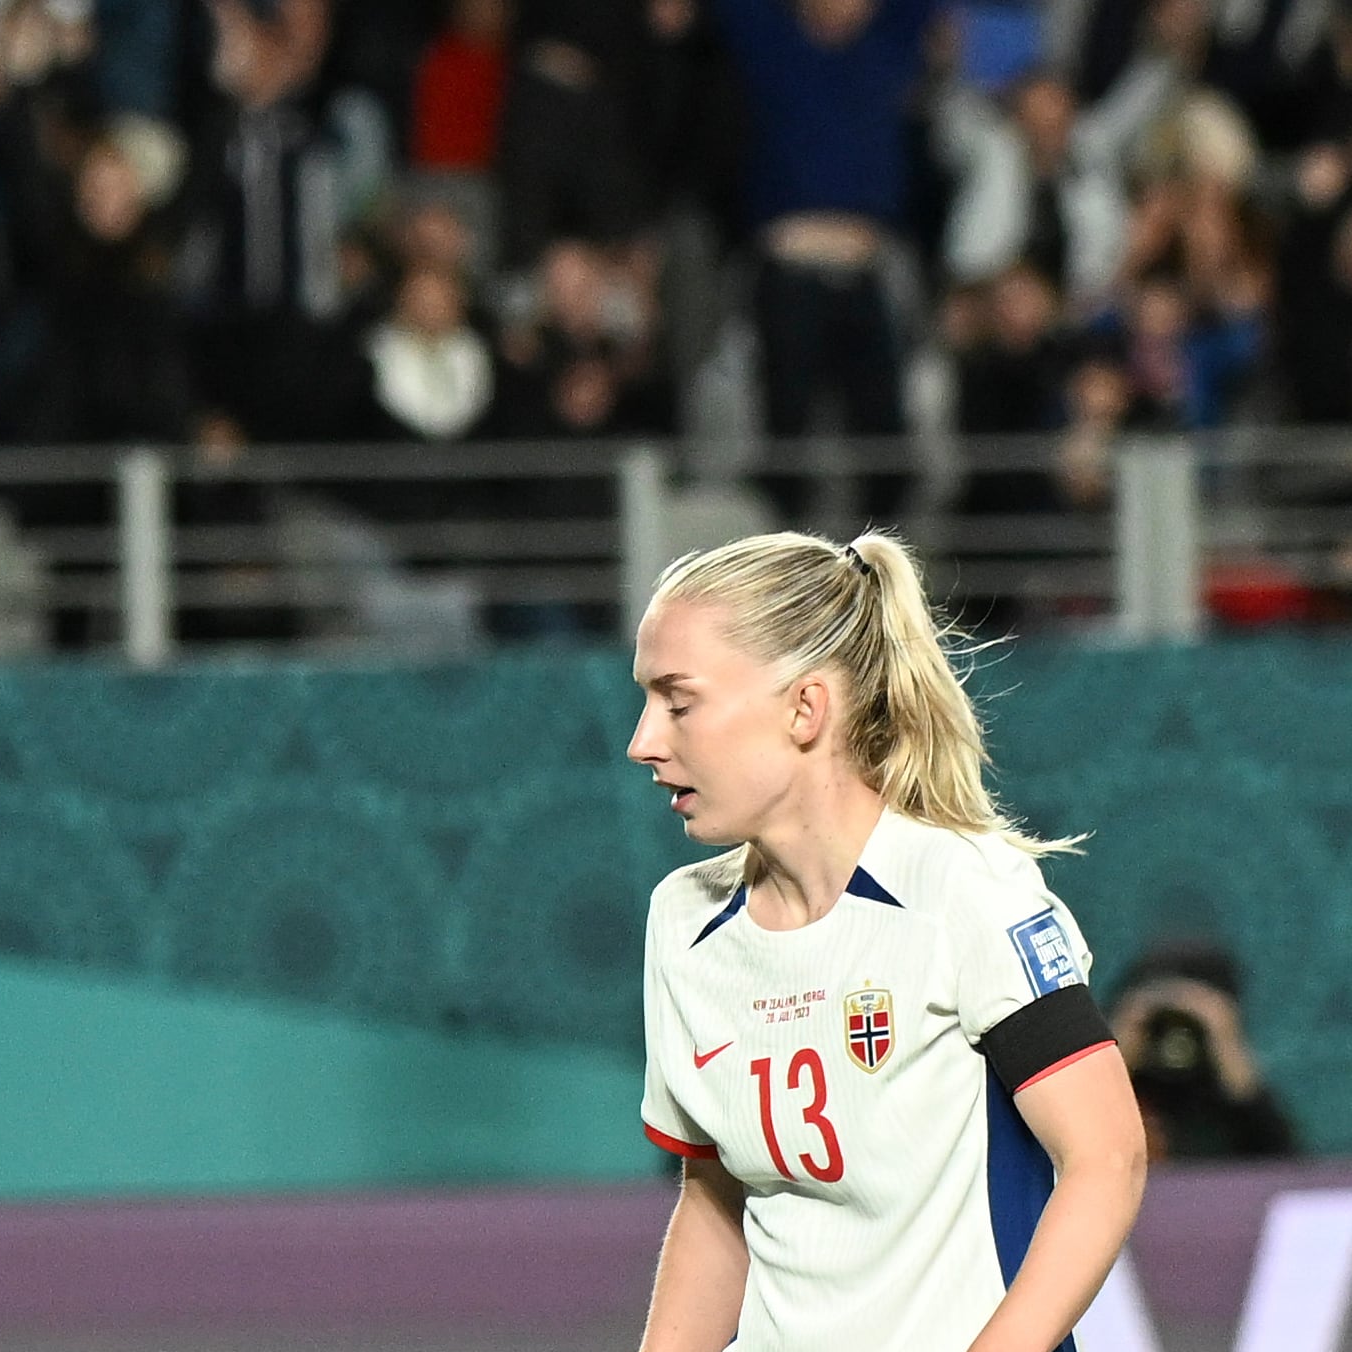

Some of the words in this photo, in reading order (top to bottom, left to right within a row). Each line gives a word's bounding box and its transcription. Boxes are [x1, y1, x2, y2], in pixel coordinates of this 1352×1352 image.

[769, 995, 797, 1010] ZEALAND
[803, 989, 826, 1003] NORGE
[750, 1048, 844, 1183] 13
